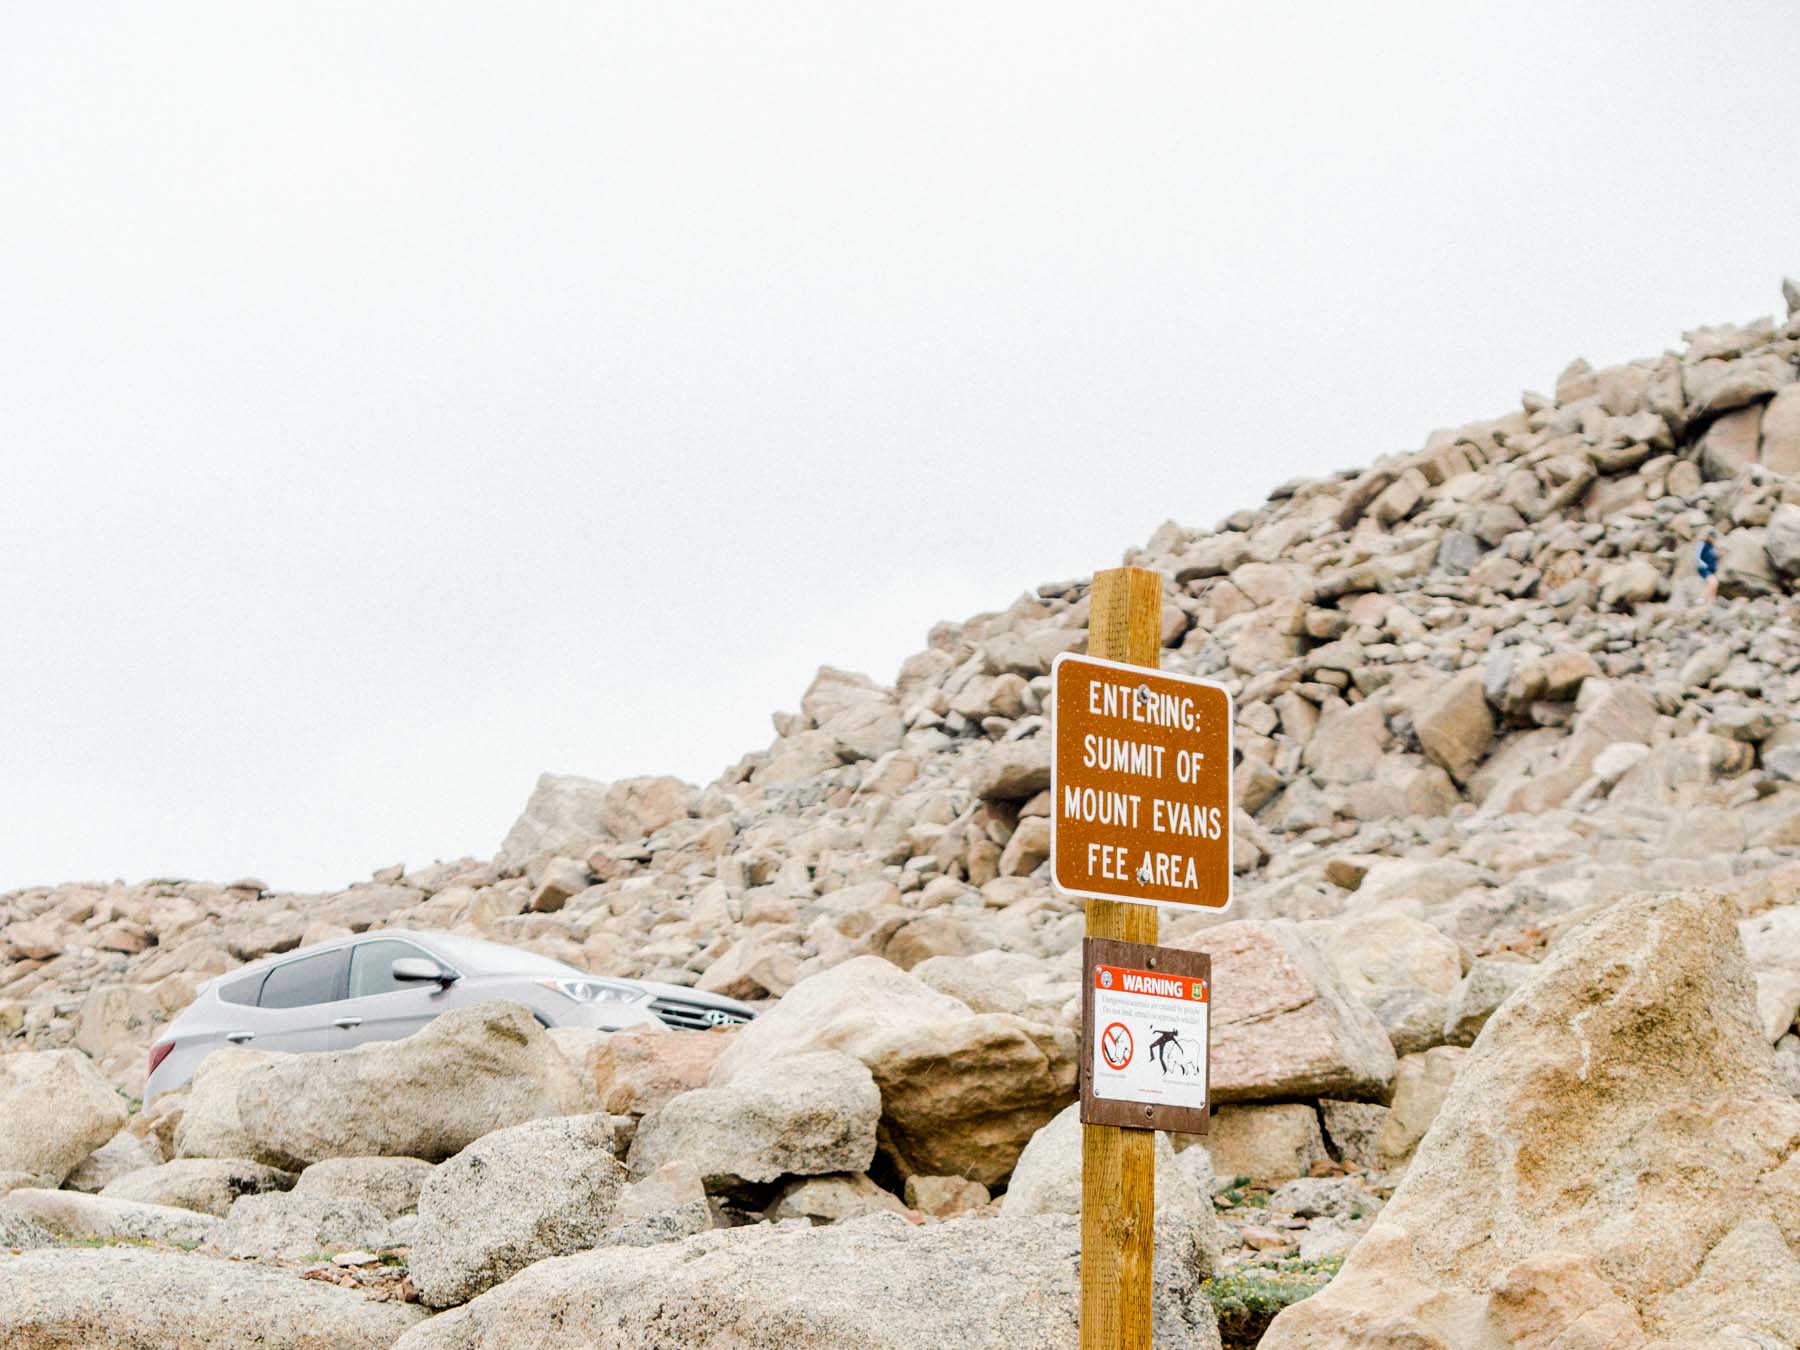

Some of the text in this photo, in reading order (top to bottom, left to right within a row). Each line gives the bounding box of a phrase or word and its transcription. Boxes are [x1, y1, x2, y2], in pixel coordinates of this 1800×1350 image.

[1089, 680, 1201, 733] ENTERING:
[1083, 734, 1204, 784] SUMMIT OF
[1064, 785, 1222, 841] MOUNT EVANS
[1088, 843, 1199, 890] FEE AREA
[1122, 973, 1183, 997] WARNING
